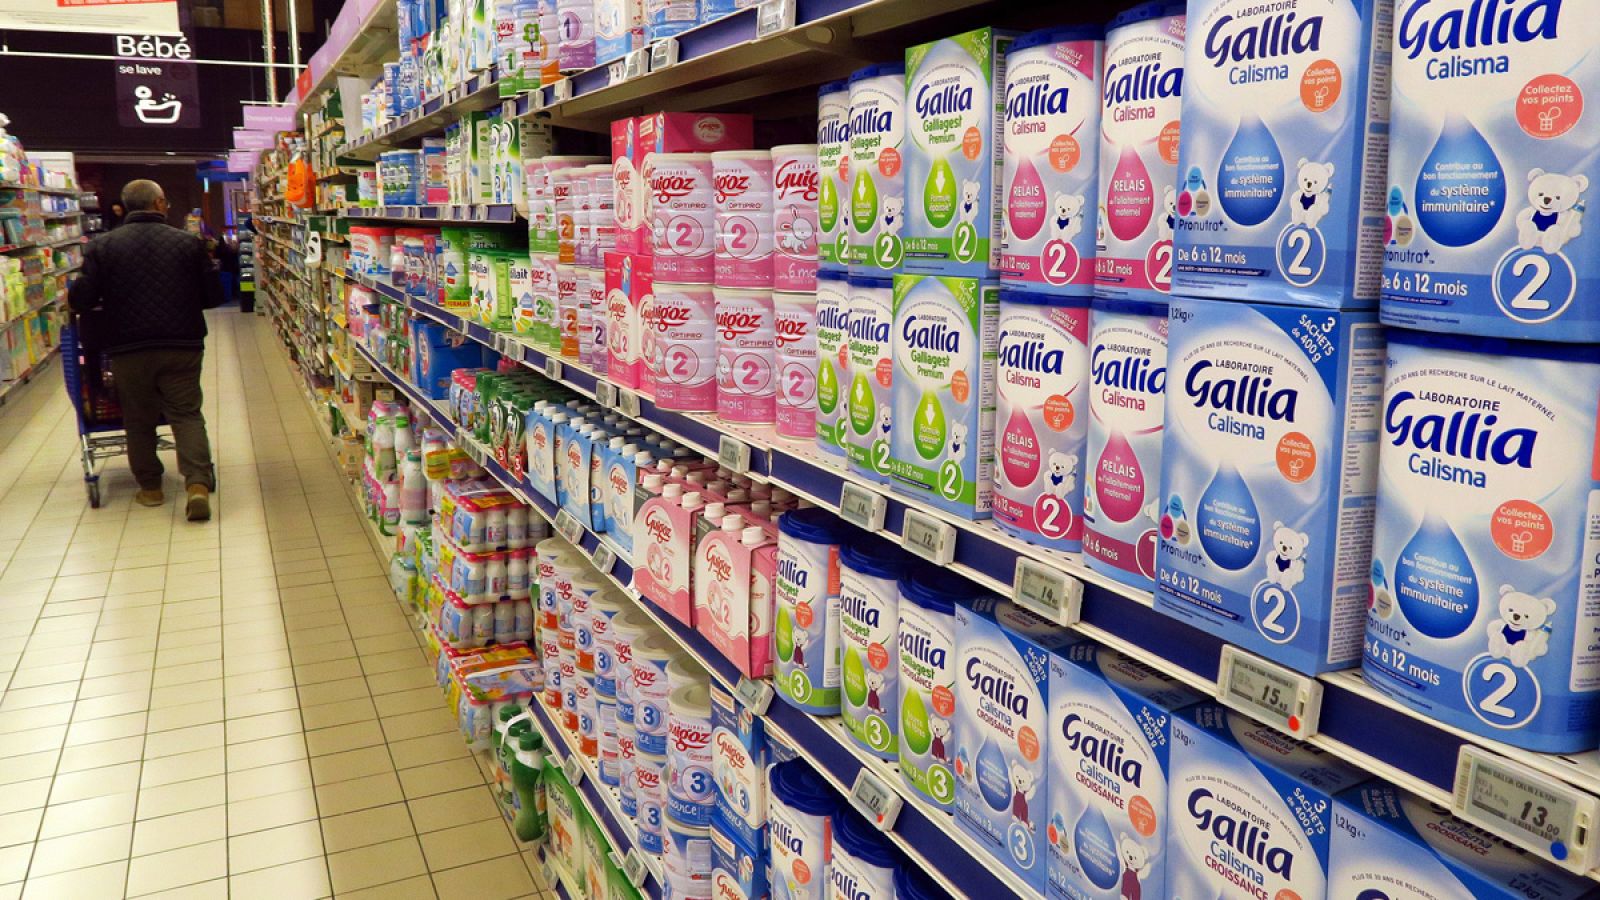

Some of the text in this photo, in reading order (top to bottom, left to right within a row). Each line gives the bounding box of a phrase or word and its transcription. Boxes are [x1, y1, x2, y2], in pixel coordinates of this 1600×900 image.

[1236, 1, 1297, 19] LABORATOIRE
[1204, 12, 1323, 68] Gallia
[1399, 0, 1562, 59] Gallia
[116, 35, 192, 59] Bébé
[1118, 51, 1162, 67] LABORATOIRE
[119, 64, 162, 76] se lave
[1229, 64, 1289, 85] Calisma
[1306, 68, 1336, 77] Collectez
[1317, 75, 1337, 86] points
[1426, 55, 1509, 81] Calisma
[1103, 62, 1184, 109] Gallia
[1525, 85, 1572, 95] Collectez
[915, 83, 973, 119] Gallia
[1005, 83, 1069, 122] Gallia
[1522, 94, 1574, 106] vos points
[922, 114, 963, 135] Galliagest
[1112, 105, 1156, 123] Calisma
[928, 133, 956, 145] Premium
[1011, 120, 1046, 136] Calisma
[1113, 179, 1145, 192] RELAIS
[1239, 174, 1273, 187] système
[1438, 170, 1498, 181] fonctionnement
[1013, 184, 1040, 197] RELAIS
[1440, 183, 1489, 199] système
[728, 201, 762, 210] OPTIPRO
[675, 222, 693, 246] 2
[731, 223, 747, 249] 2
[957, 226, 970, 256] 2
[880, 235, 894, 262] 2
[1048, 243, 1068, 278] 2
[1178, 246, 1246, 264] De 6 à 12 mois
[1288, 228, 1312, 276] 2
[1155, 244, 1173, 284] 2
[1392, 272, 1401, 290] 6
[1403, 276, 1411, 291] à
[1415, 273, 1430, 293] 12
[1434, 280, 1468, 296] mois
[1511, 254, 1551, 310] 2
[918, 313, 948, 323] LABORATOIRE
[1321, 316, 1336, 333] 3
[739, 338, 773, 348] OPTIPRO
[903, 315, 960, 354] Gallia
[1008, 330, 1045, 341] LABORATOIRE
[1299, 314, 1335, 356] SACHETS
[910, 351, 950, 368] Galliagest
[998, 330, 1064, 376] Gallia
[1106, 343, 1152, 357] LABORATOIRE
[672, 351, 688, 375] 2
[742, 360, 760, 385] 2
[916, 365, 945, 381] Premium
[1091, 343, 1168, 395] Gallia
[1215, 359, 1274, 376] LABORATOIRE
[789, 370, 805, 397] 2
[1005, 369, 1041, 389] Calisma
[1184, 359, 1298, 423] Gallia
[1101, 388, 1146, 412] Calisma
[1418, 390, 1501, 412] LABORATOIRE
[1428, 369, 1556, 422] RECHERCHE SUR LE LAIT MATERNEL
[1207, 412, 1265, 440] Calisma
[1384, 391, 1539, 469] Gallia
[1006, 433, 1034, 449] RELAIS
[877, 443, 891, 469] 2
[943, 463, 957, 495] 2
[1102, 459, 1136, 479] RELAIS
[1407, 452, 1487, 489] Calisma
[1041, 498, 1060, 533] 2
[1496, 515, 1546, 530] vos points
[1499, 505, 1544, 521] Collectez
[664, 563, 671, 581] 2
[1160, 568, 1223, 604] De 6 à 12 mois
[1417, 575, 1464, 599] système
[723, 606, 730, 625] 2
[1262, 587, 1286, 634] 2
[1372, 639, 1379, 657] 6
[1381, 648, 1389, 664] à
[1391, 648, 1406, 672] 12
[1408, 662, 1441, 687] mois
[793, 674, 804, 698] 3
[966, 656, 1029, 720] Gallia
[1261, 684, 1282, 705] 15
[1479, 663, 1517, 718] 2
[643, 706, 653, 724] 3
[979, 696, 1013, 726] Calisma
[869, 719, 882, 746] 3
[1083, 717, 1125, 746] LABORATOIRE
[716, 731, 746, 769] Guigoz
[1062, 713, 1143, 789] Gallia
[690, 771, 706, 795] 3
[933, 770, 948, 798] 3
[1079, 758, 1121, 796] Calisma
[1075, 771, 1125, 810] CROISSANCE
[648, 806, 659, 822] 3
[1215, 793, 1272, 831] LABORATOIRE
[1293, 787, 1327, 836] SACHETS
[1314, 799, 1327, 813] 3
[1519, 800, 1549, 828] 13
[1014, 829, 1028, 861] 3
[1187, 787, 1294, 882] Gallia
[1424, 821, 1490, 857] CROISSANCE
[1210, 840, 1265, 887] Calisma
[1204, 855, 1269, 900] CROISSANCE
